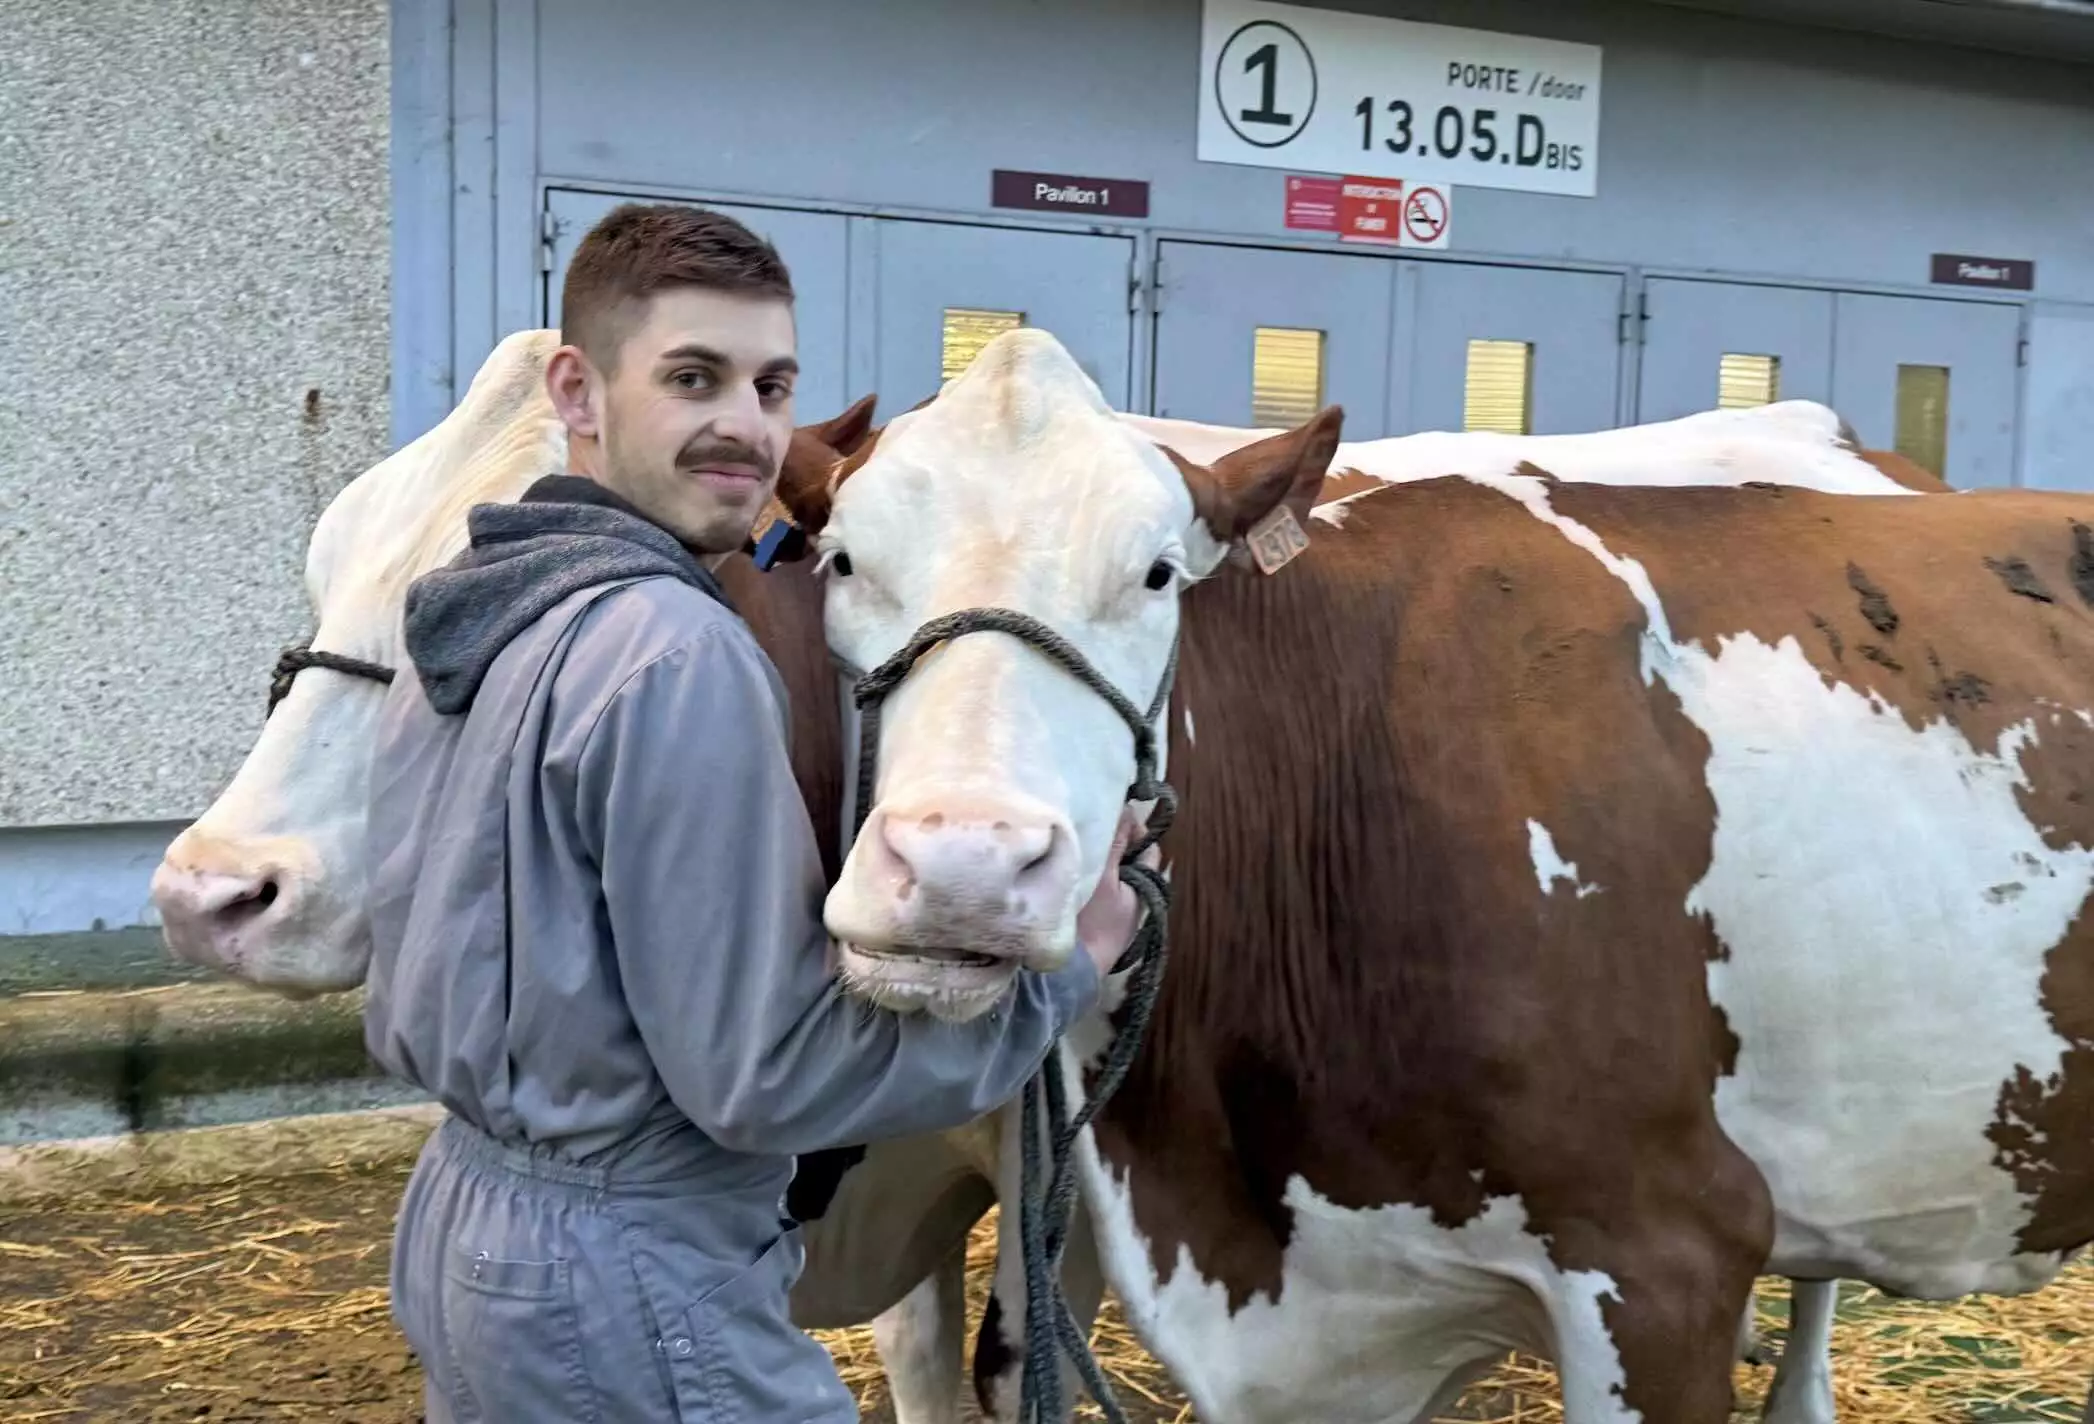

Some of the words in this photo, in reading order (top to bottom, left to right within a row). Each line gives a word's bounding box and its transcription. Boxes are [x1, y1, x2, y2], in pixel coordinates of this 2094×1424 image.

[1241, 44, 1293, 126] 1
[1448, 62, 1520, 94] PORTE
[1100, 188, 1109, 206] 1
